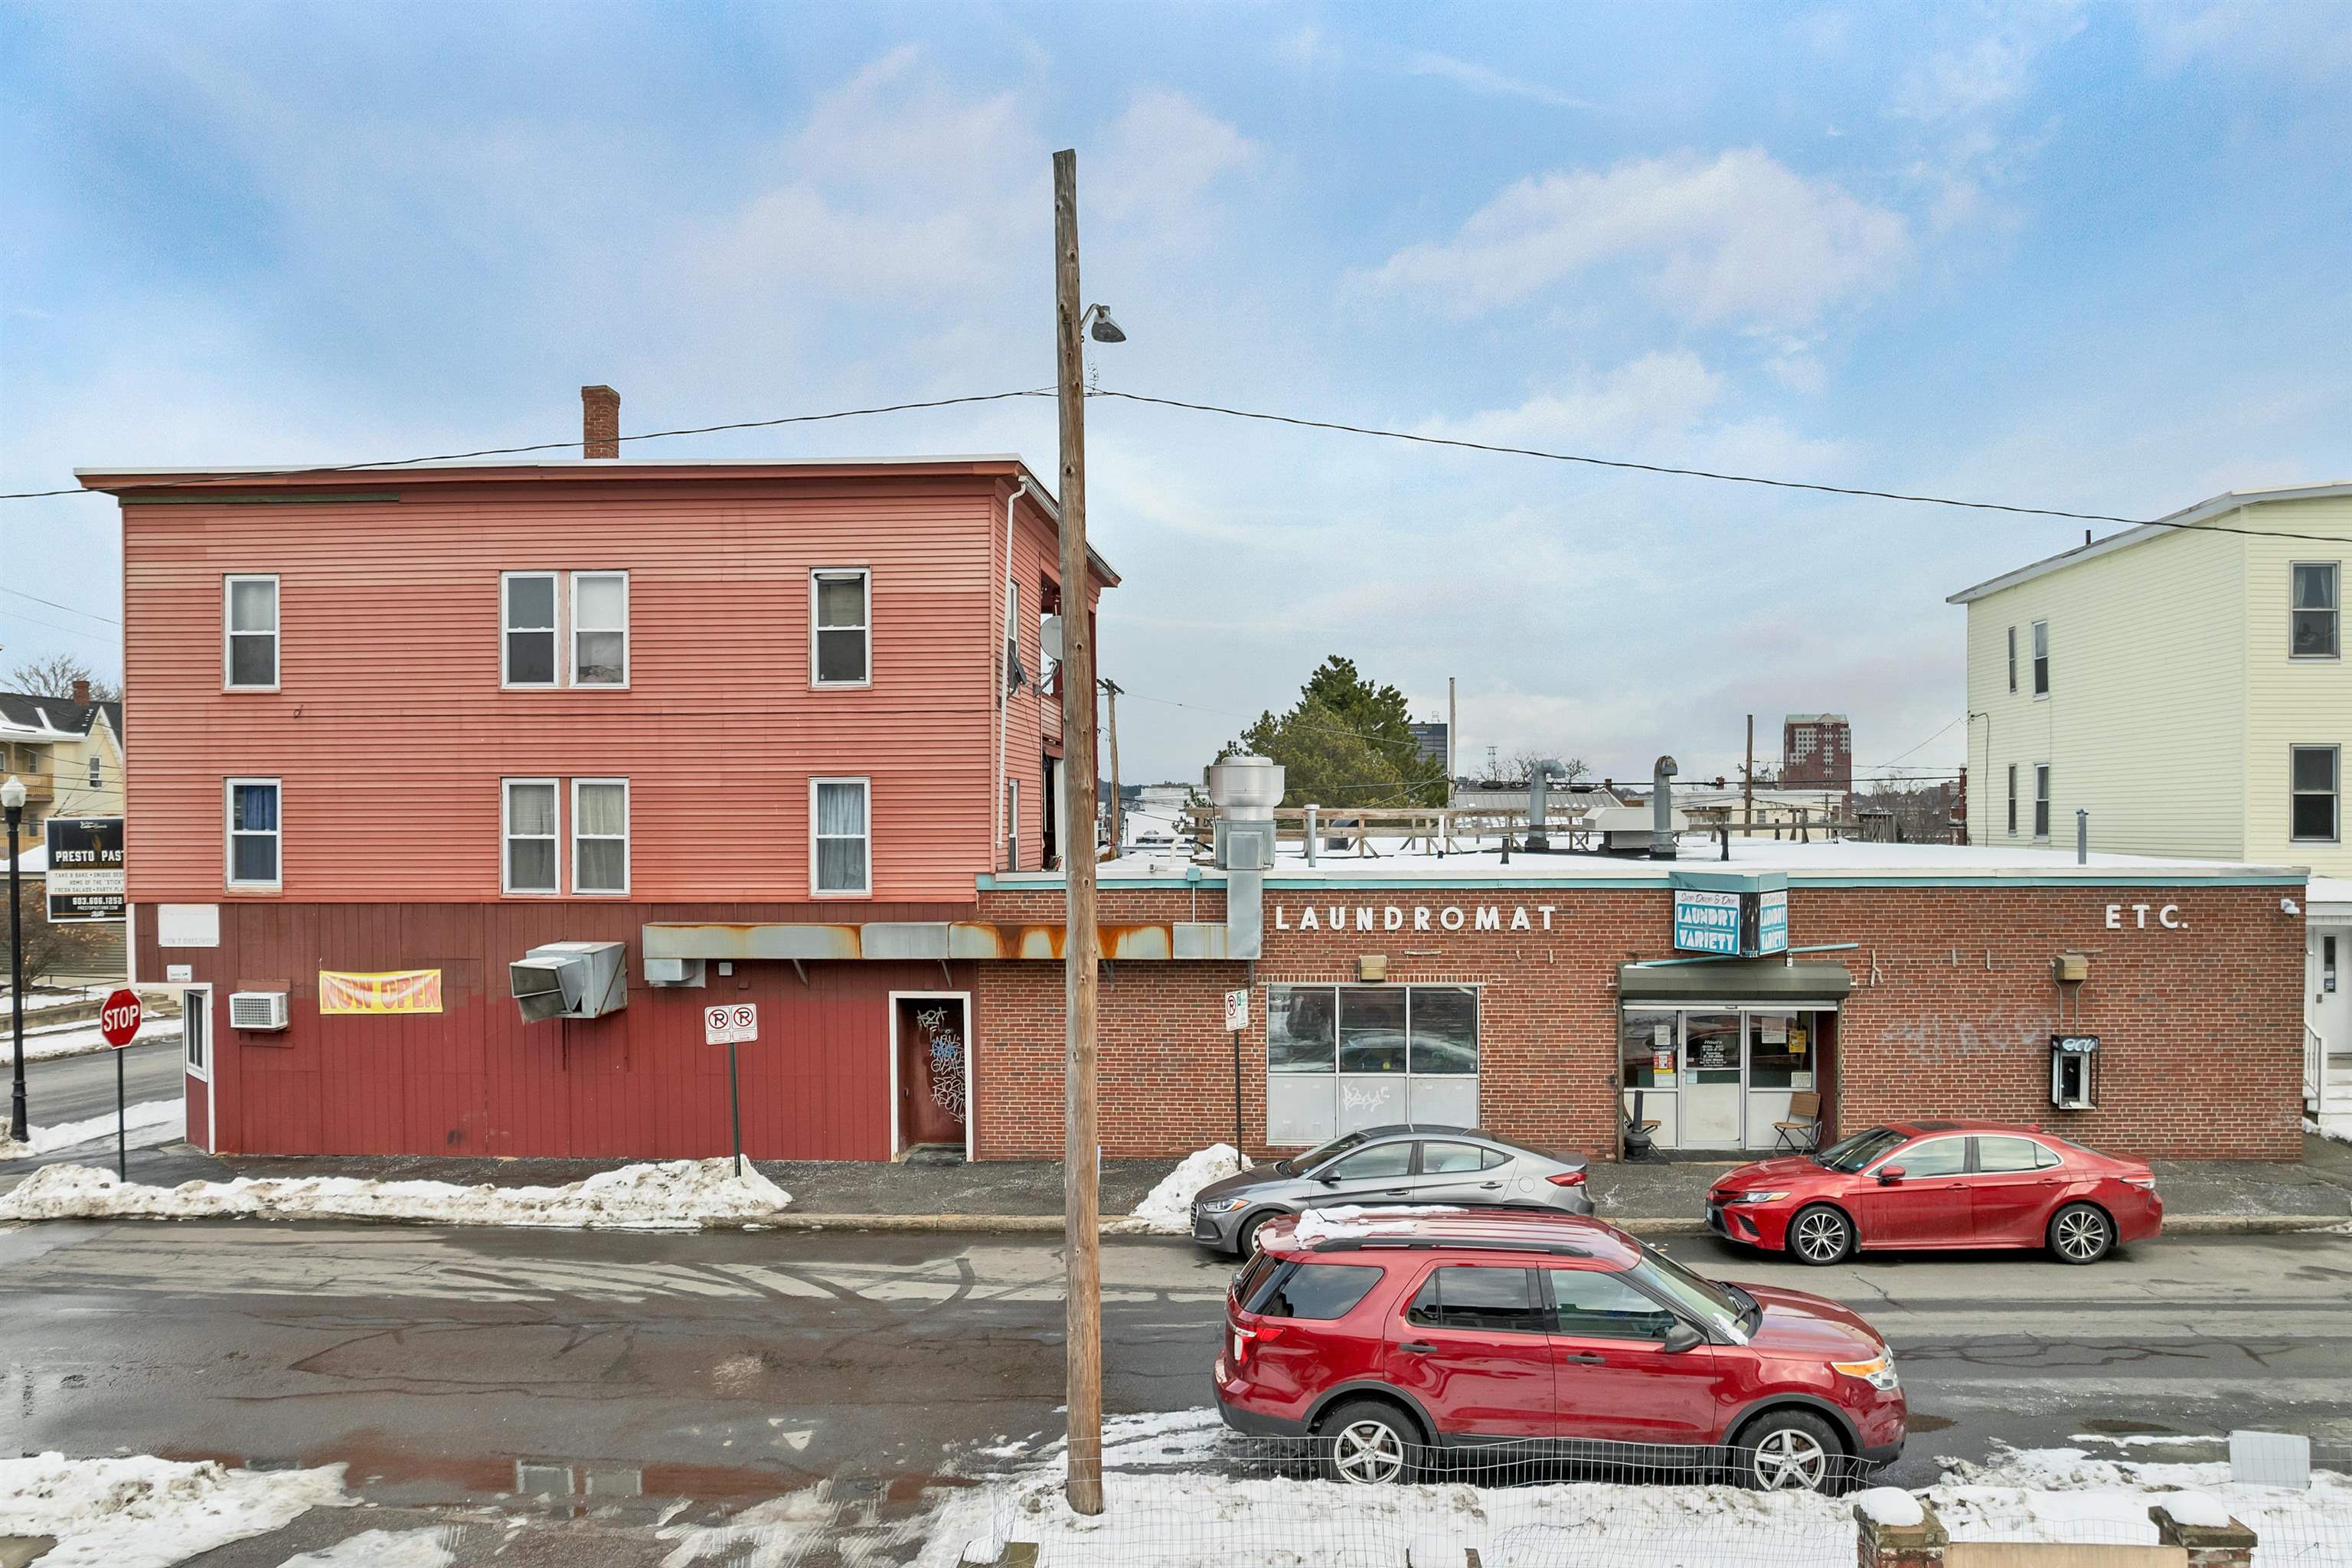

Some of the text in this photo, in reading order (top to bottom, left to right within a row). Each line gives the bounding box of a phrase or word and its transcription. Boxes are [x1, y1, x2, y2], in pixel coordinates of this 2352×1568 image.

[55, 851, 95, 862] PRESTO
[1275, 906, 1557, 931] LAUNDROMAT
[1677, 906, 1737, 927] LAUNDRY
[2105, 904, 2188, 929] ETC.
[1679, 929, 1735, 951] VARIETY
[322, 974, 440, 1009] NOW OPEN
[103, 1004, 139, 1032] STOP
